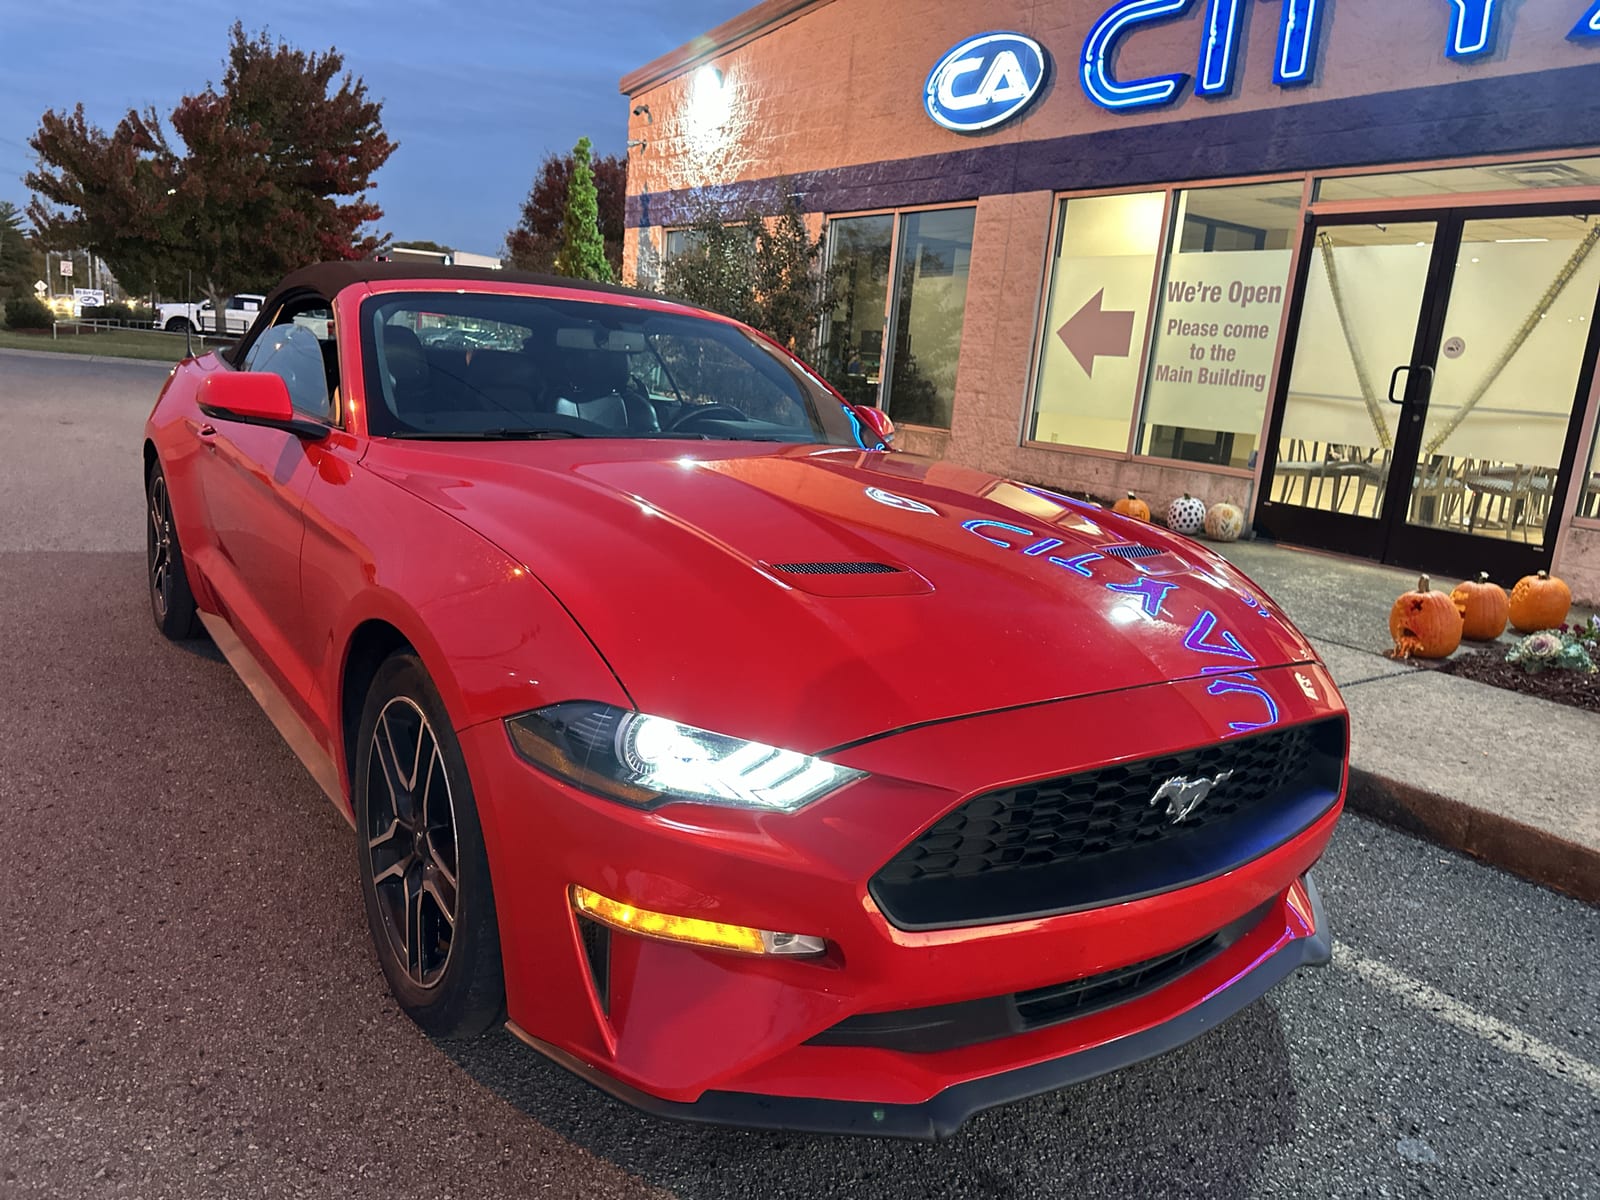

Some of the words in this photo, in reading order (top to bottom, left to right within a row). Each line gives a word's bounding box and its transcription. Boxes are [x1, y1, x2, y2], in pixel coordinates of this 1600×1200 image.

[938, 50, 1032, 111] CA
[1167, 281, 1222, 303] We're
[1228, 280, 1282, 308] Open
[1167, 319, 1219, 337] Please
[1223, 323, 1269, 339] come
[1190, 343, 1205, 361] to
[1210, 344, 1236, 362] the
[1155, 364, 1193, 384] Main
[1197, 367, 1267, 392] Building
